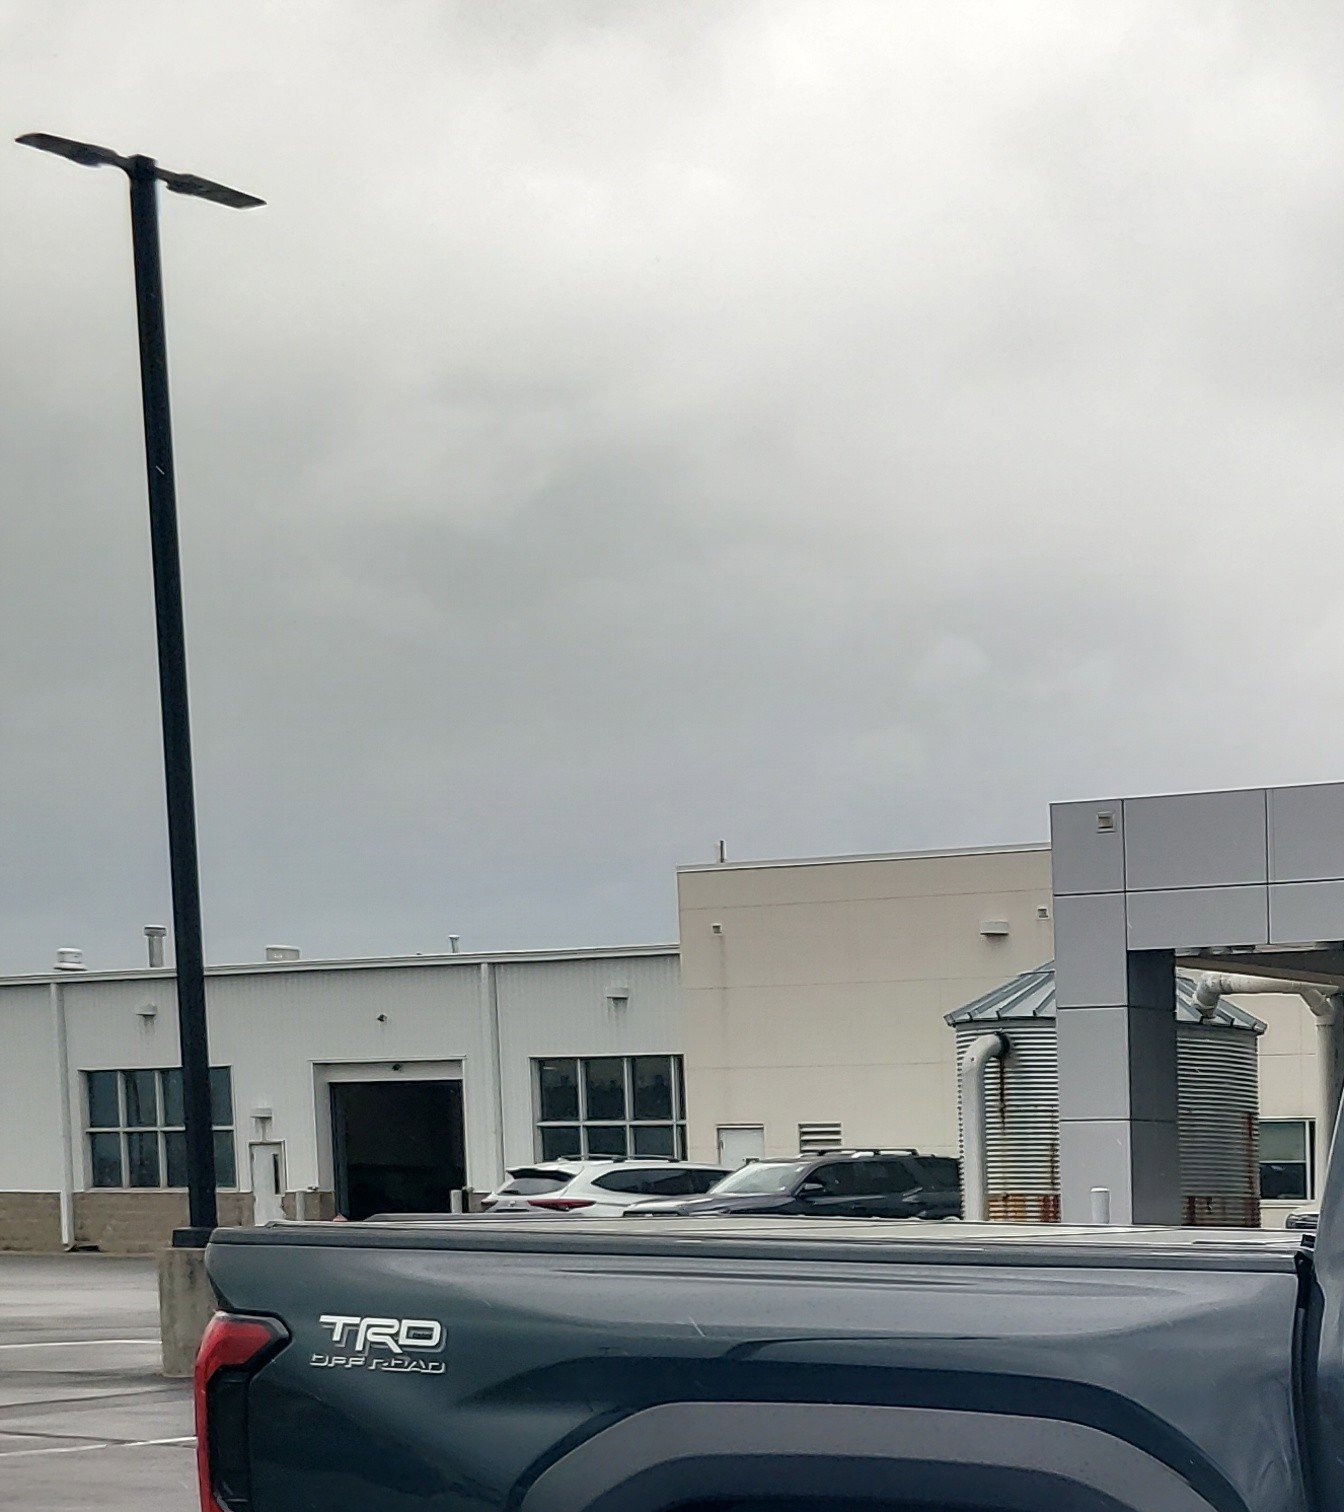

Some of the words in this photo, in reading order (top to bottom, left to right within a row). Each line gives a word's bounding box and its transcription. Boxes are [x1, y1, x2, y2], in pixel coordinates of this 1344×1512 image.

[319, 1315, 445, 1353] TRD
[309, 1353, 365, 1368] OFF
[368, 1357, 446, 1374] ROAD
